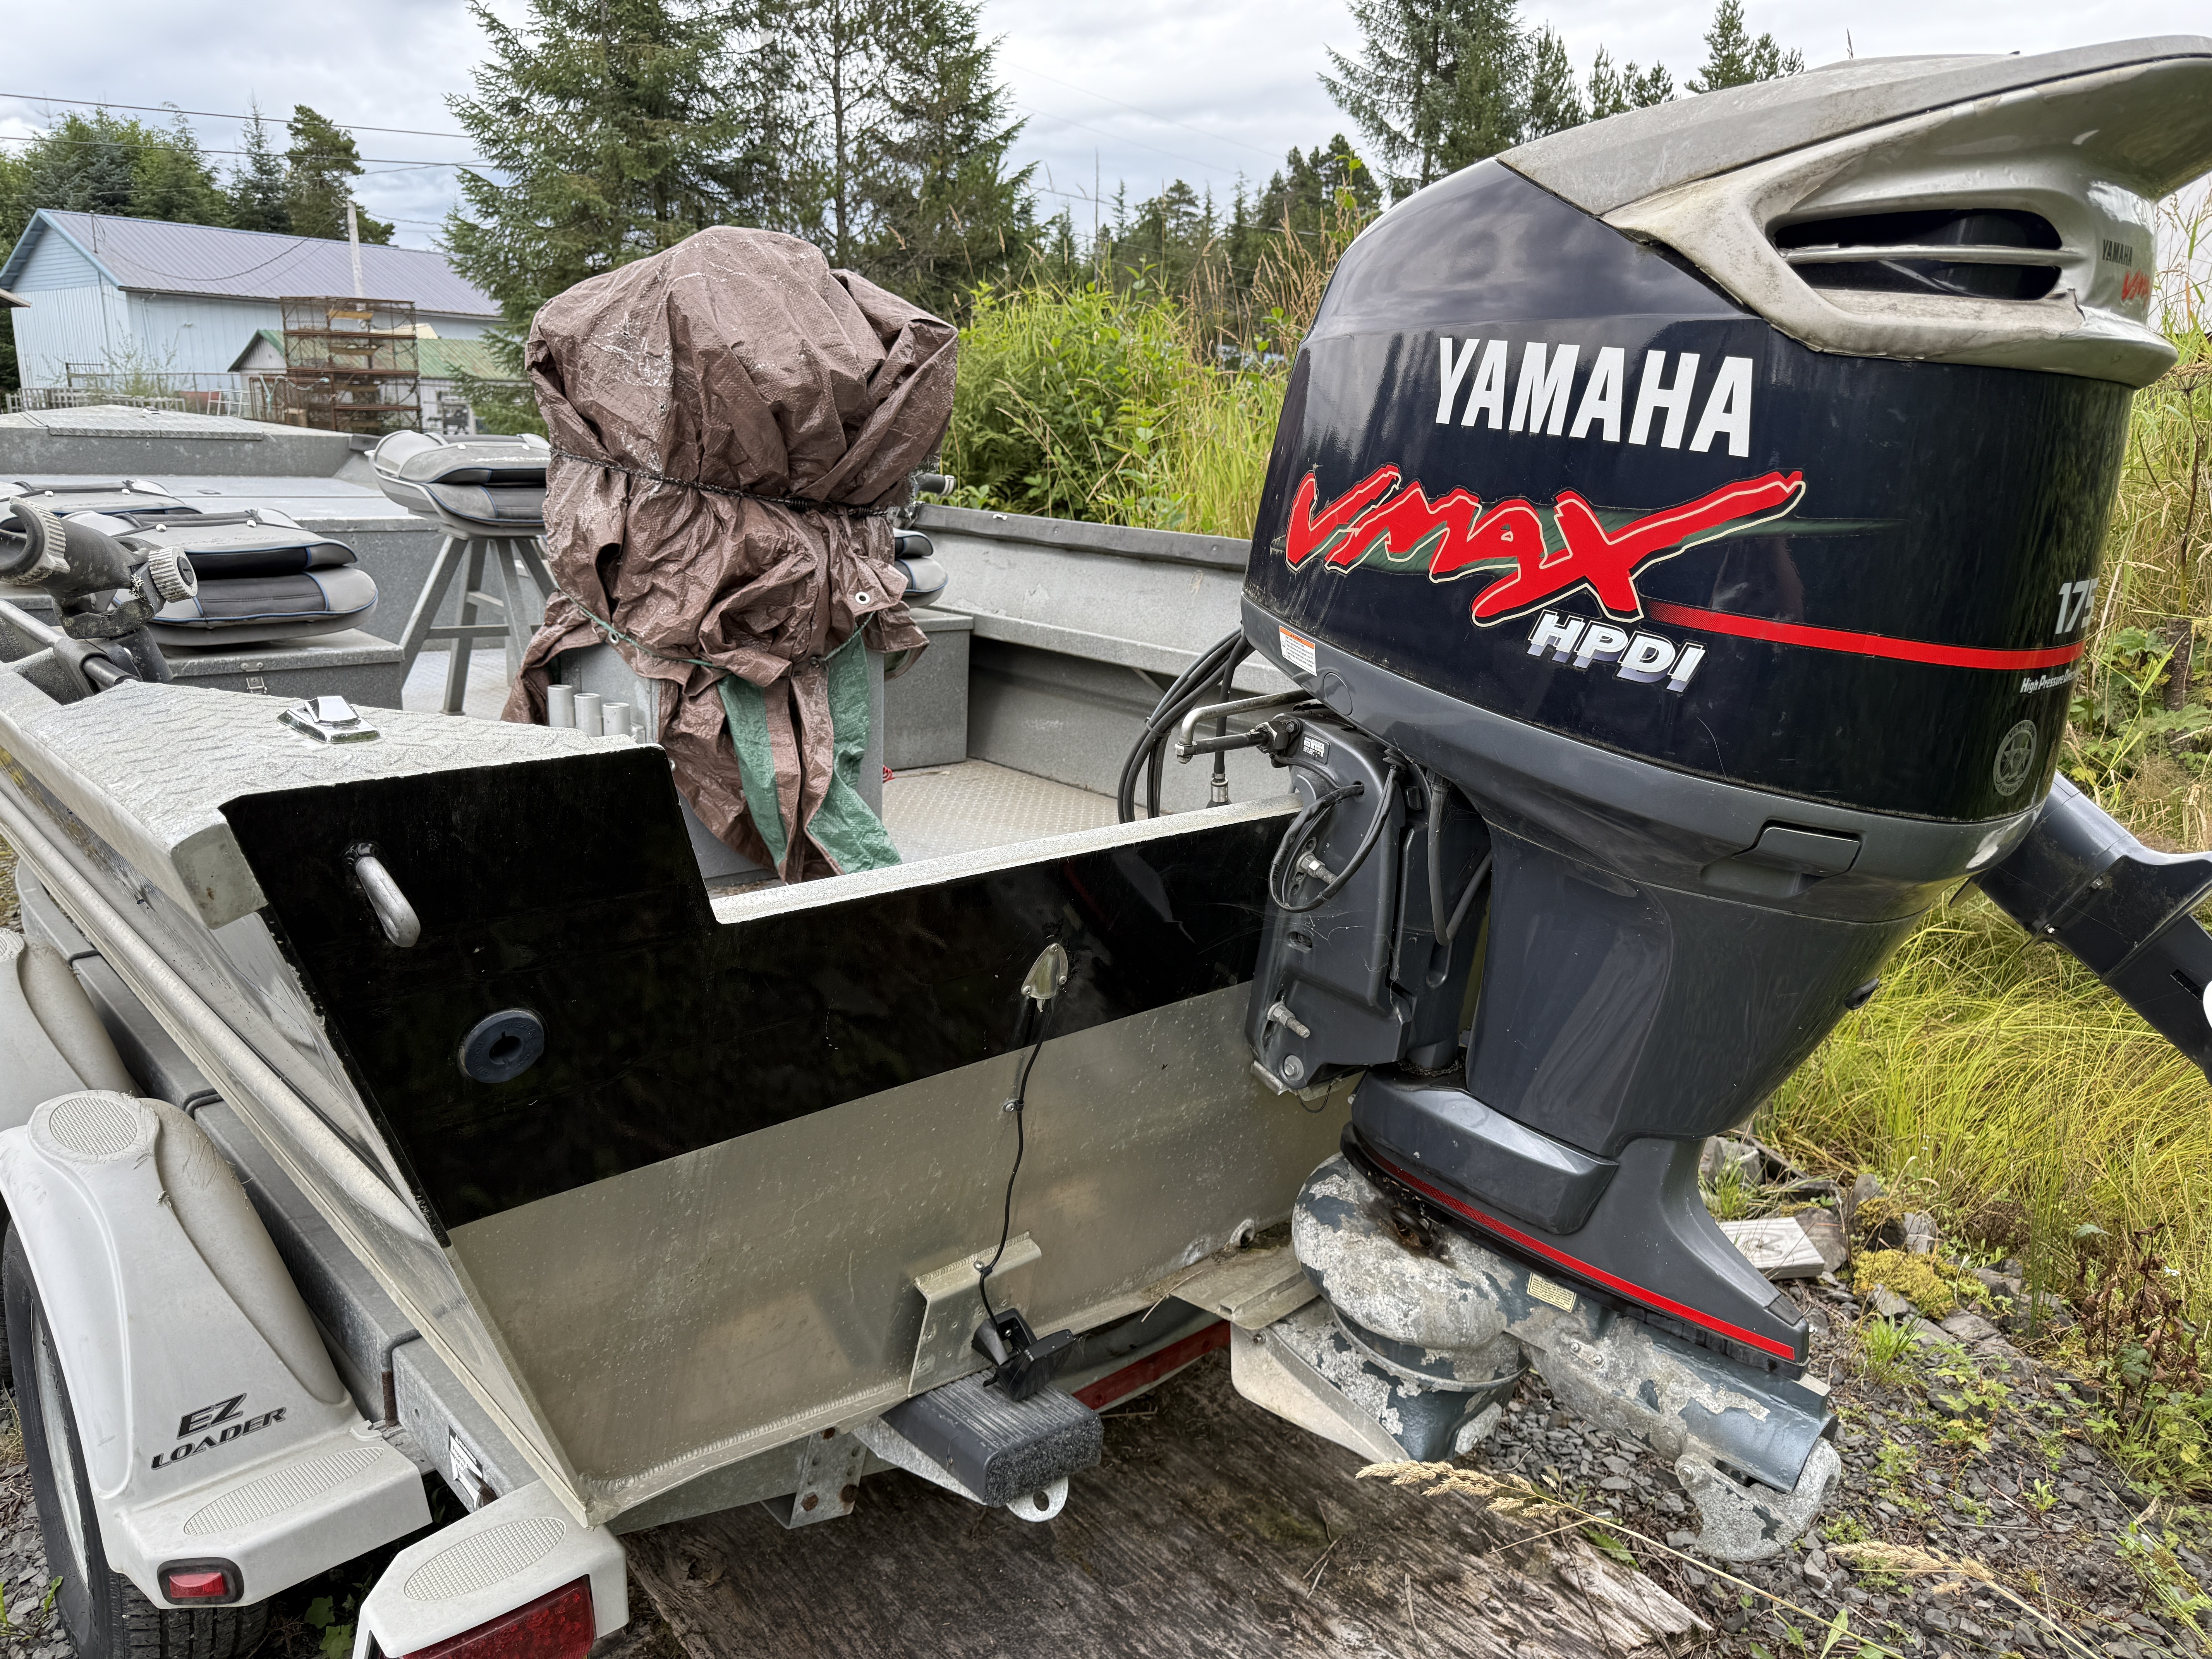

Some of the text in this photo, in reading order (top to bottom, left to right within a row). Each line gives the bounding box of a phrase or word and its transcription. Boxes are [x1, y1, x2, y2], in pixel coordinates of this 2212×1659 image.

[2102, 239, 2133, 267] YAMAHA
[1435, 337, 1753, 457] YAMAHA
[1285, 464, 1805, 627] VMAX
[2055, 576, 2100, 634] 175
[1527, 609, 1706, 692] HPDI
[2020, 677, 2039, 694] High
[2038, 675, 2064, 690] Pressure
[151, 1407, 287, 1471] LOADER
[177, 1393, 247, 1440] EZ
